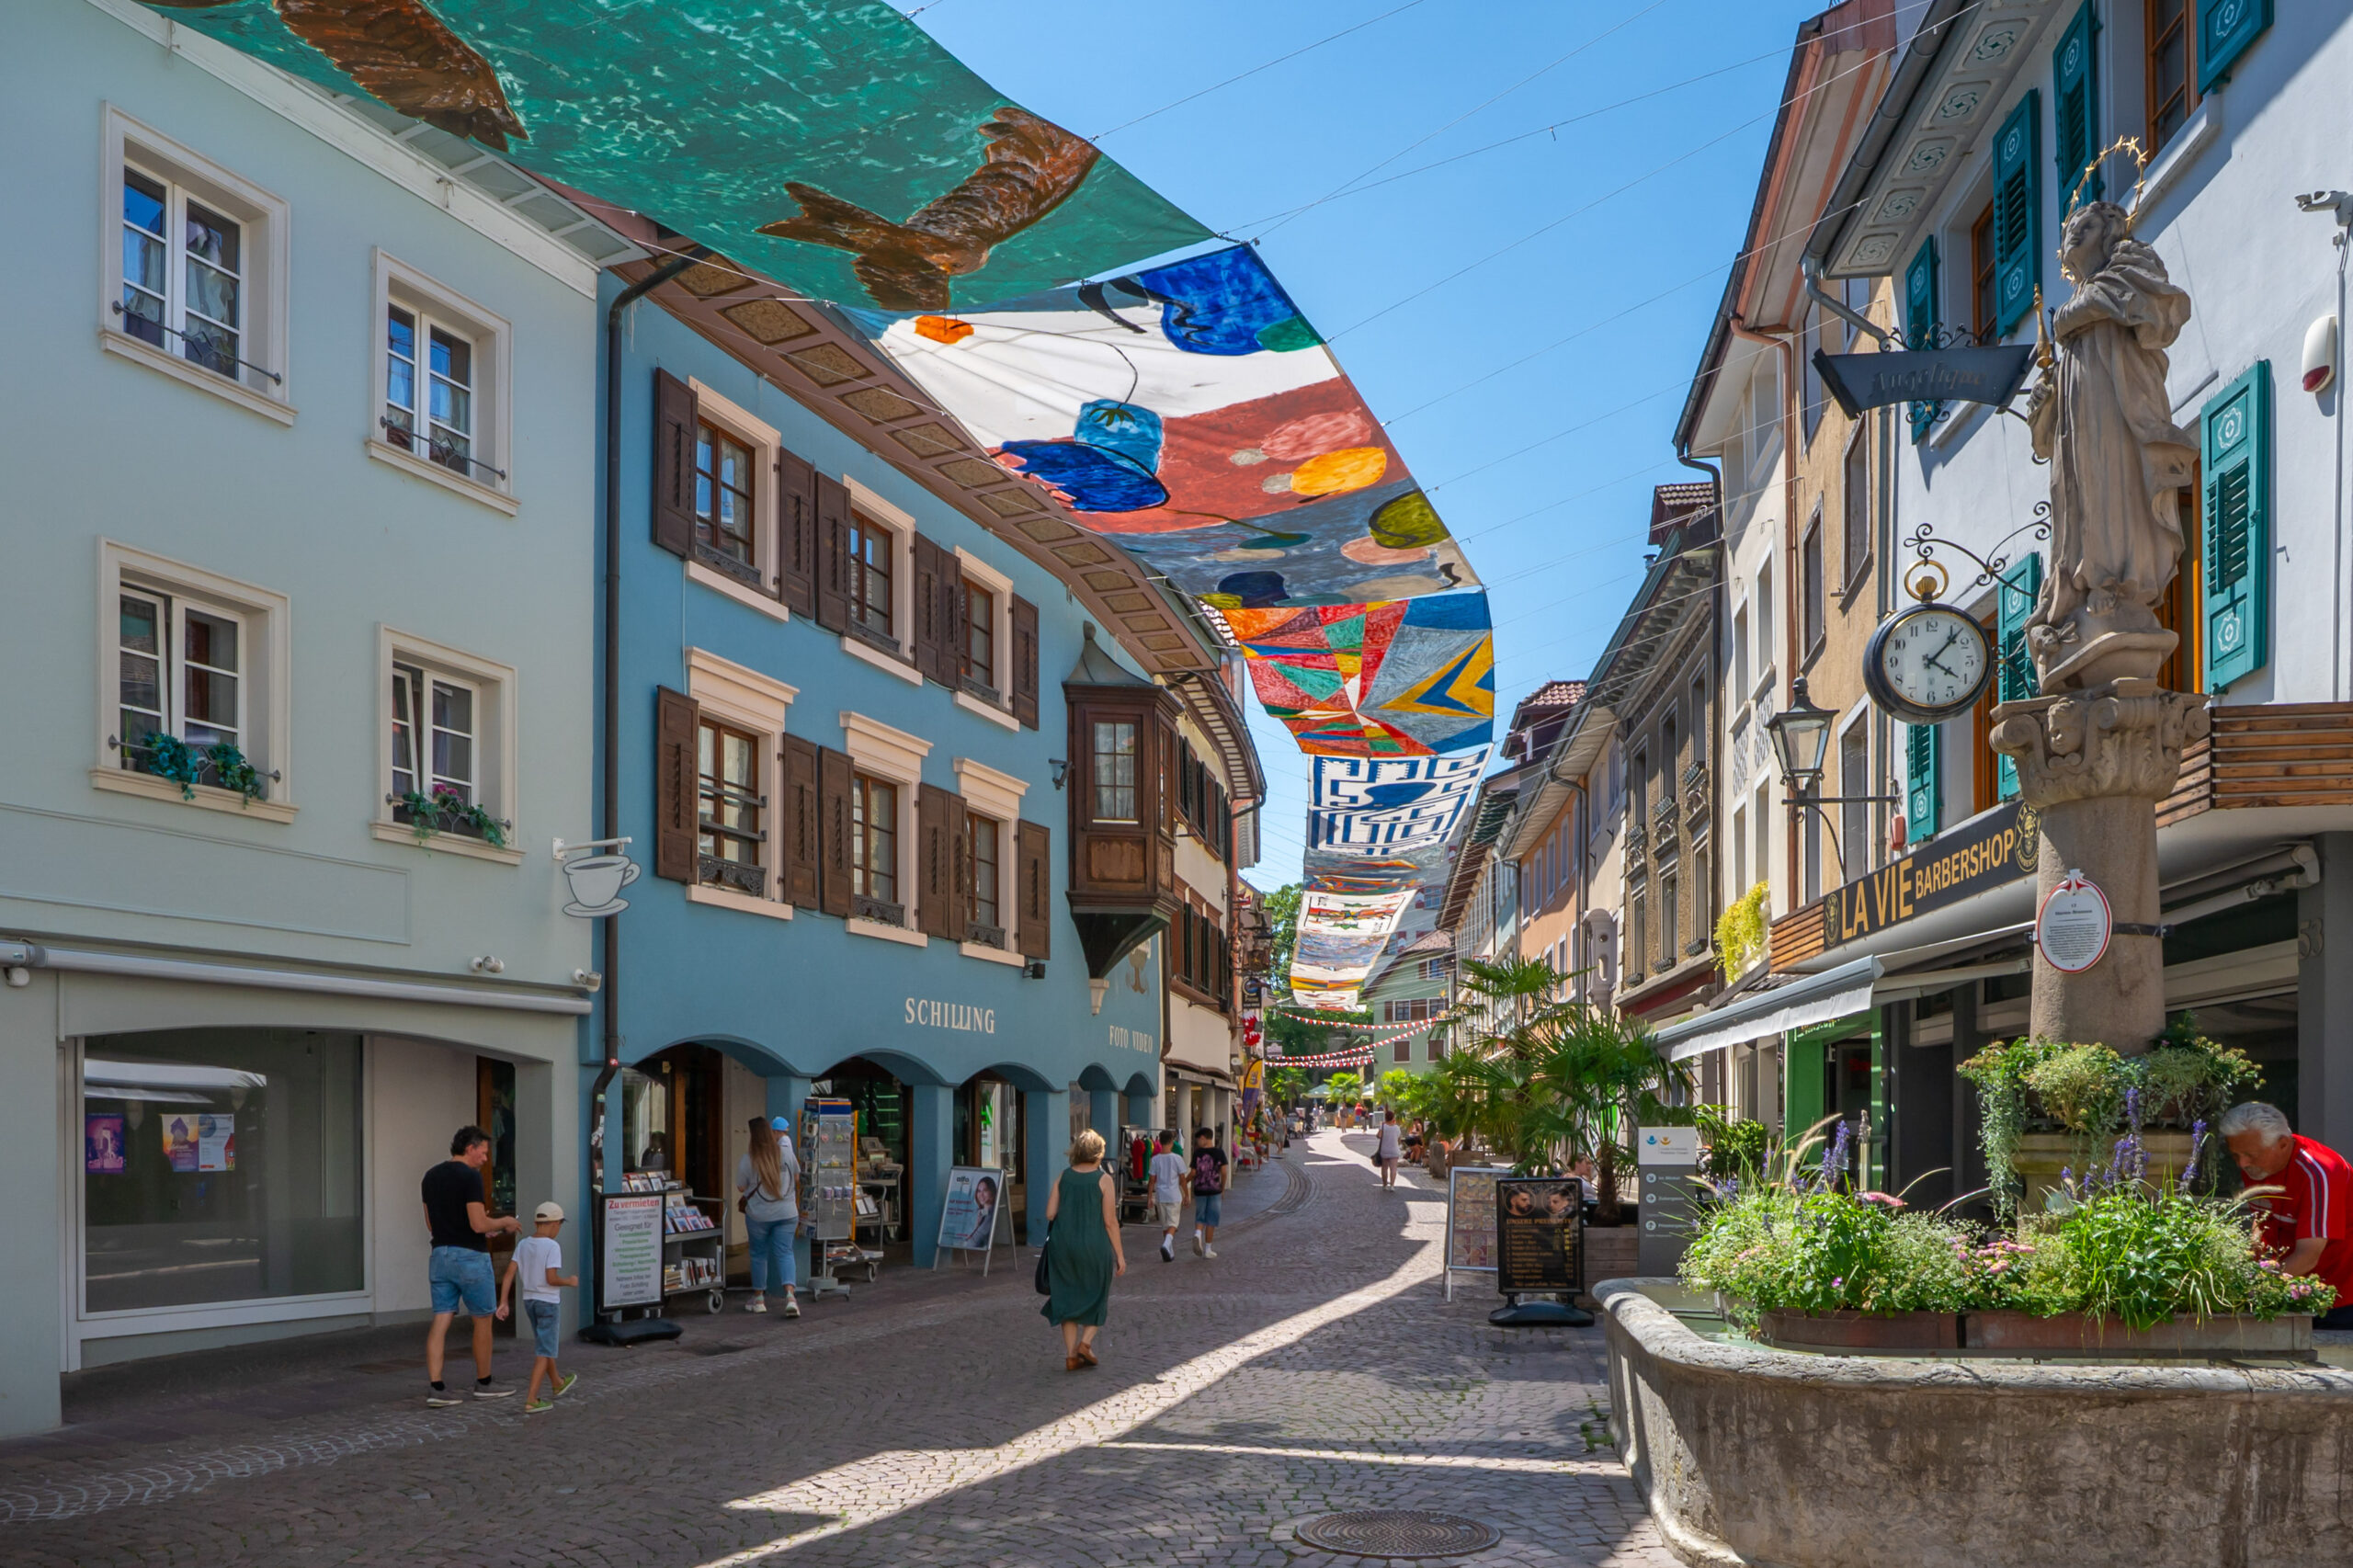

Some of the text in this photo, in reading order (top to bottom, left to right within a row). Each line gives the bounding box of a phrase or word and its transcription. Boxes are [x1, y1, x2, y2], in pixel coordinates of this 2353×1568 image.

[1871, 360, 1987, 393] Angelique
[1910, 625, 1918, 637] 11
[1927, 619, 1938, 632] 12
[1894, 638, 1906, 651] 10
[1960, 636, 1969, 650] 2
[1889, 655, 1898, 668] 9
[1894, 674, 1904, 686] 8
[1927, 691, 1936, 703] 6
[1946, 686, 1955, 699] 5
[1841, 881, 1869, 940] LA
[1873, 858, 1914, 926] VIE
[1915, 828, 2015, 900] BARBERSHOP
[2298, 917, 2324, 960] 53
[904, 997, 995, 1034] SCHILLING
[1108, 1025, 1154, 1054] FOTO VIDEO
[608, 1198, 659, 1210] Zu vermieten
